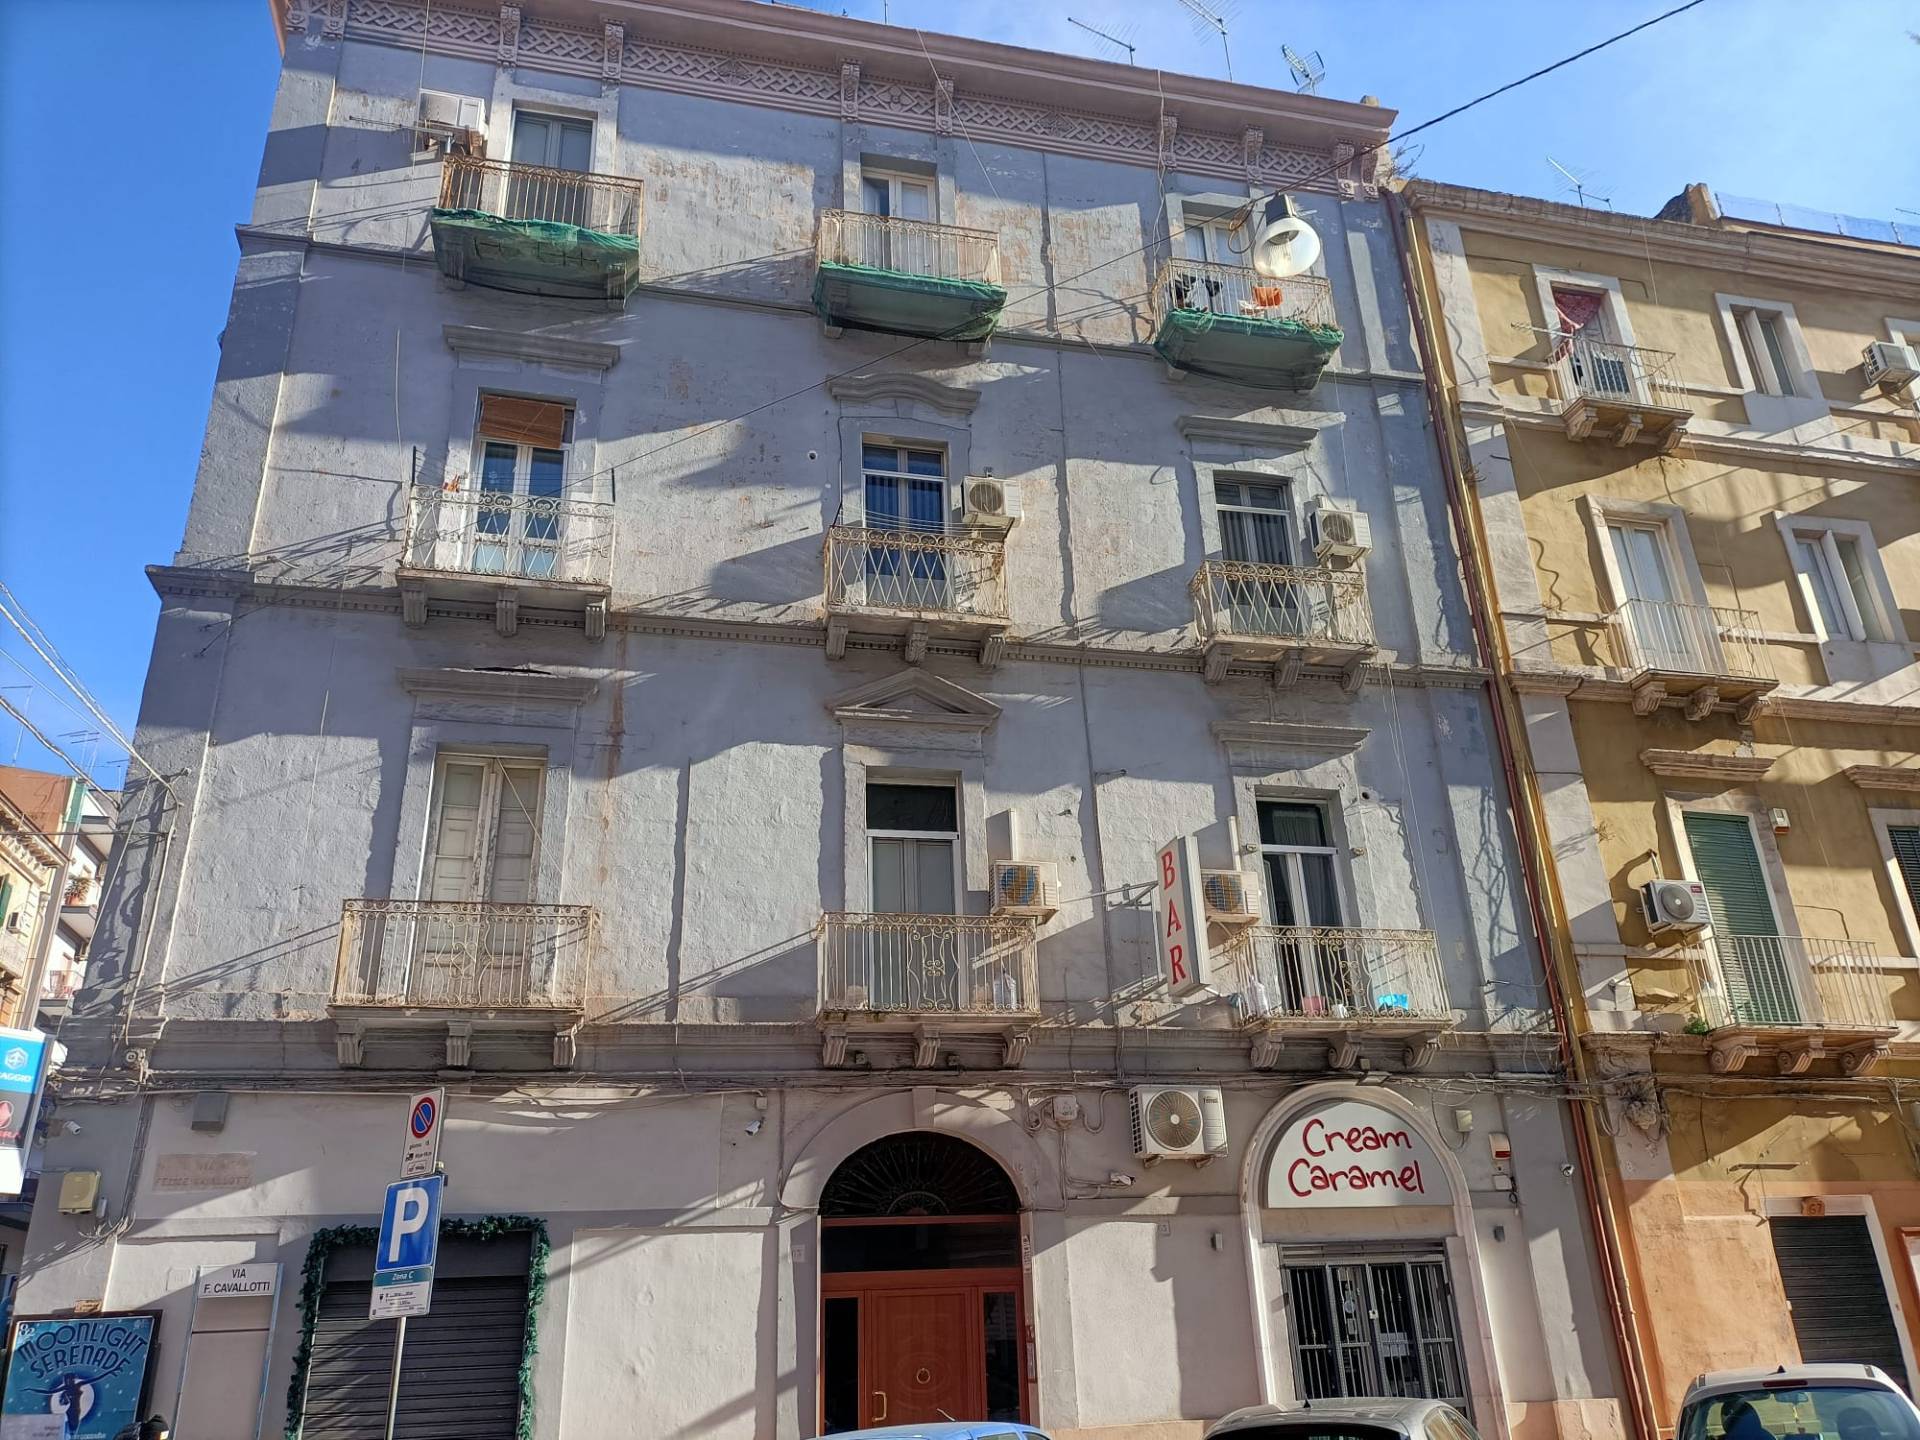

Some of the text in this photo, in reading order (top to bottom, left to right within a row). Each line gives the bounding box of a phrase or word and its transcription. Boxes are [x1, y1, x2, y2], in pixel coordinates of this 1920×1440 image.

[1161, 850, 1186, 985] BAR
[1302, 1118, 1412, 1157] Cream
[1287, 1158, 1425, 1198] Caramel
[388, 1187, 429, 1263] P
[203, 1281, 271, 1294] F. CAVALLOTTI
[232, 1268, 247, 1279] VIA
[408, 1271, 415, 1279] C
[18, 1322, 149, 1363] MOONLIGHT
[30, 1344, 131, 1379] SERENADE
